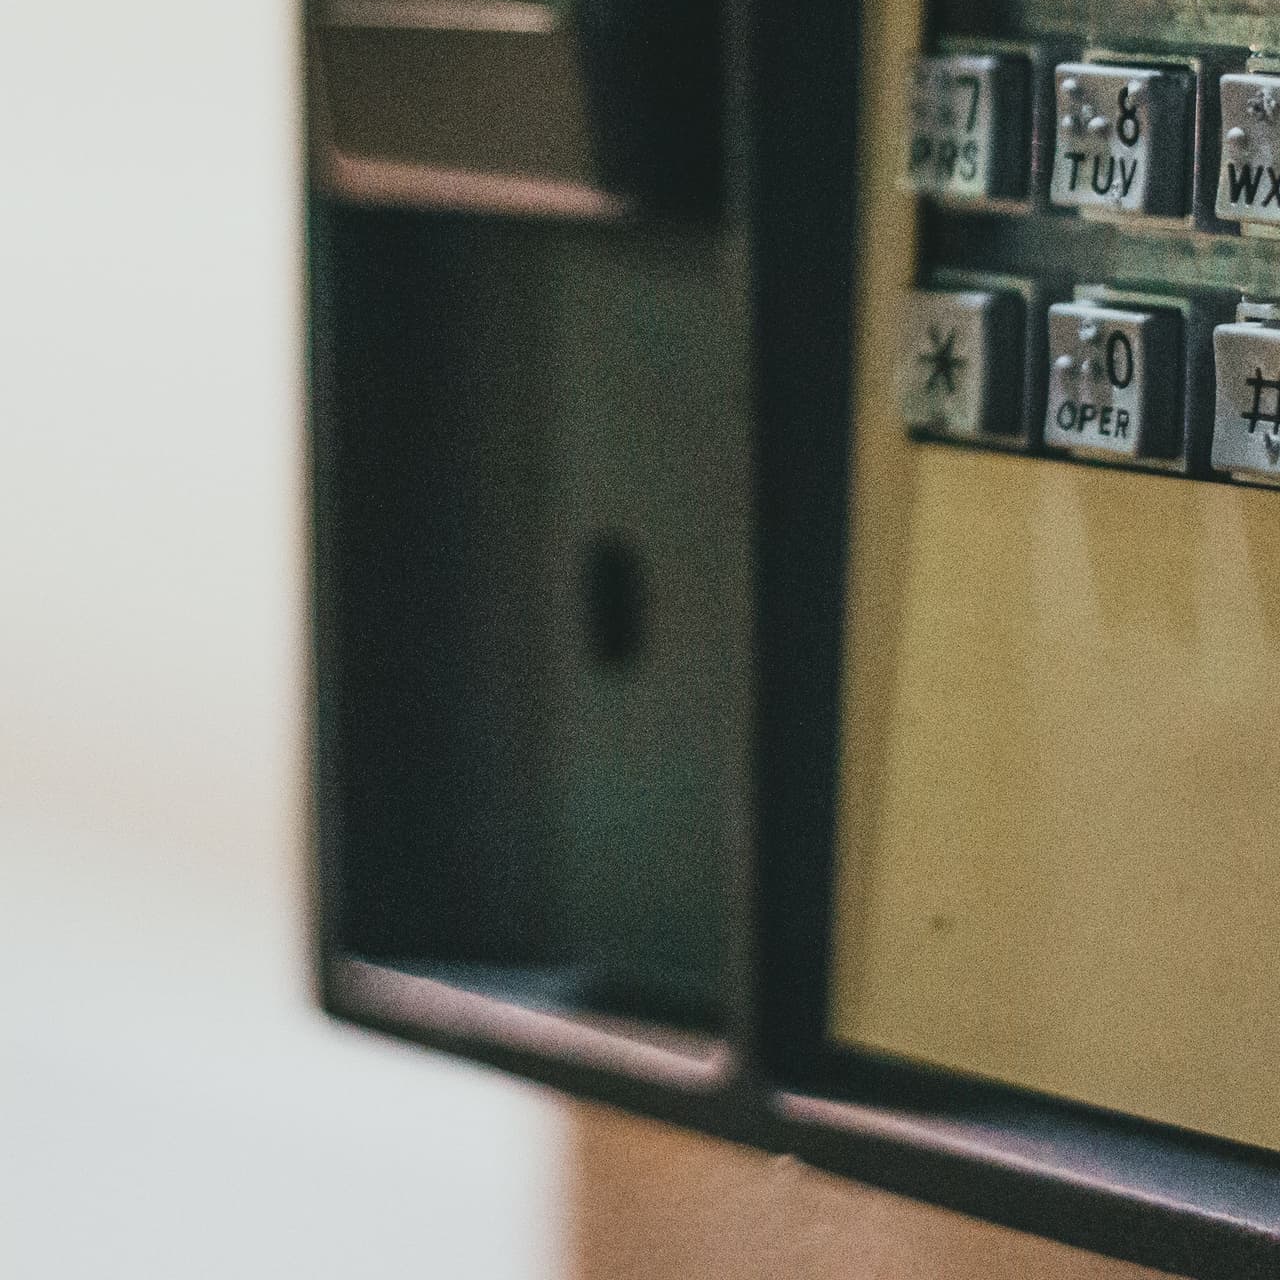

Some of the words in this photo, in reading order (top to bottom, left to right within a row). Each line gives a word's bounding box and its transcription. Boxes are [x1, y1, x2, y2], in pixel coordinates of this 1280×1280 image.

[955, 75, 981, 133] 7
[1117, 83, 1140, 148] 8
[1064, 151, 1138, 199] TUV
[1106, 330, 1133, 390] 0
[1056, 401, 1130, 440] OPER
